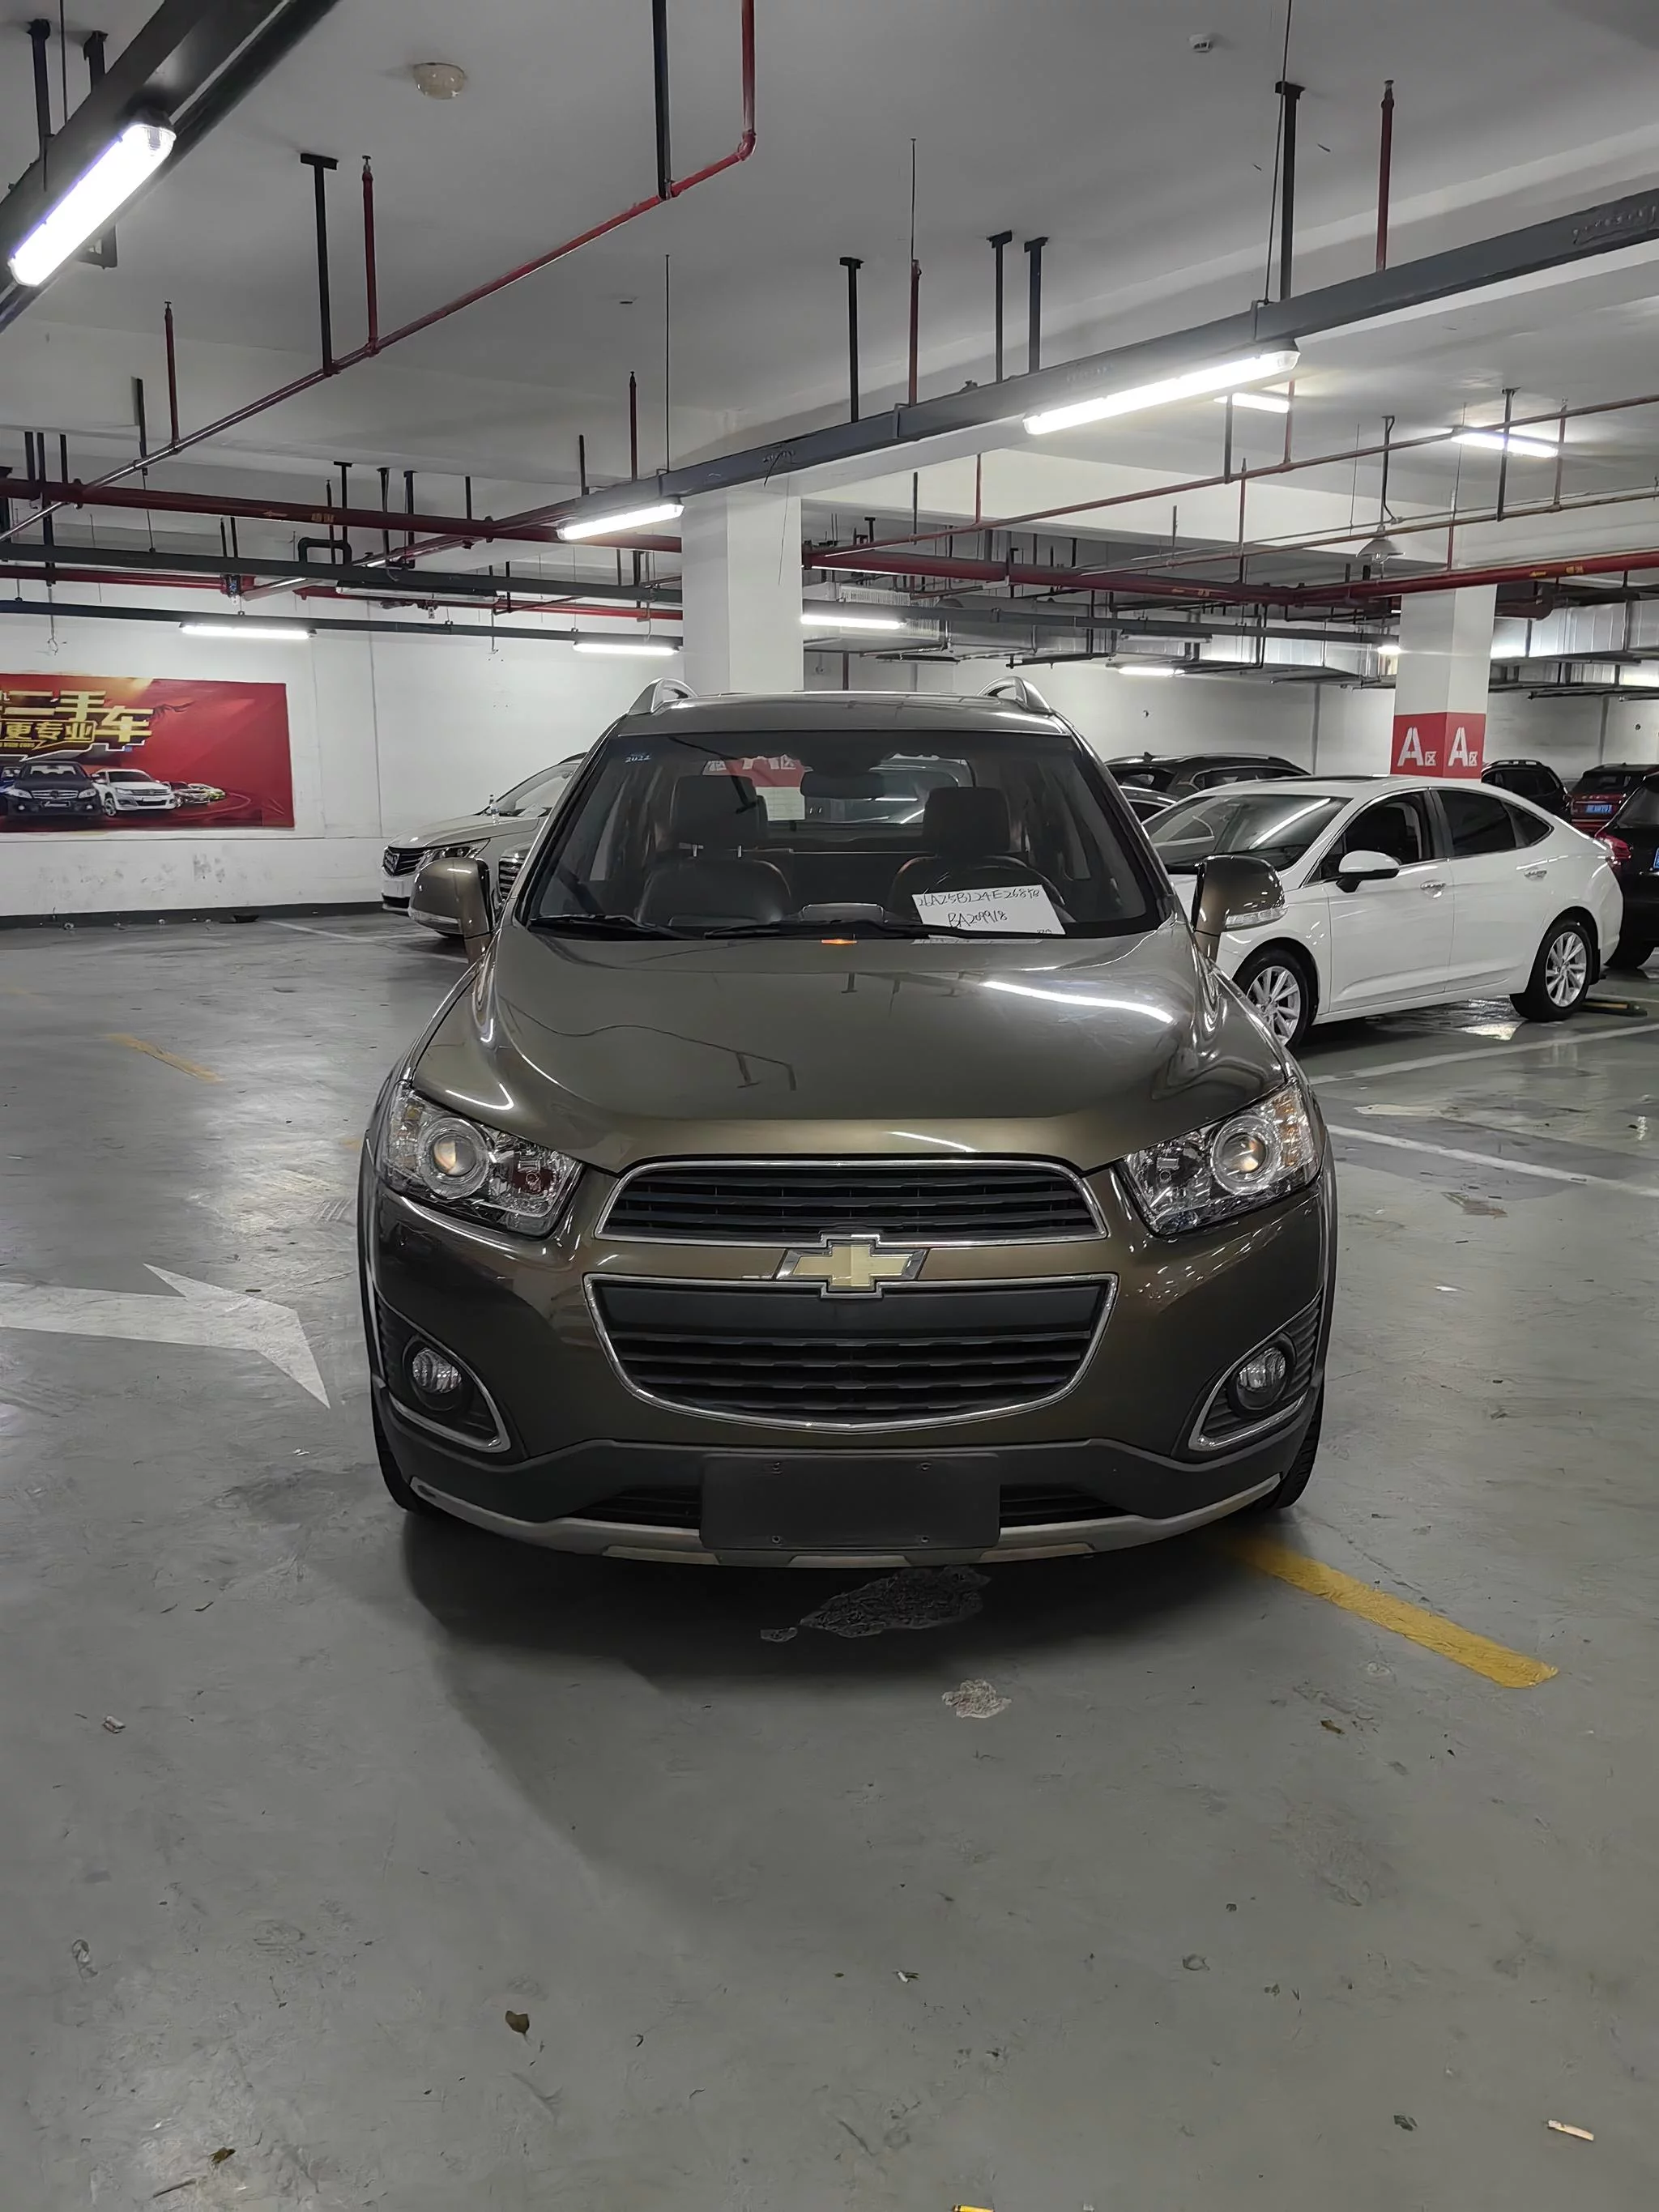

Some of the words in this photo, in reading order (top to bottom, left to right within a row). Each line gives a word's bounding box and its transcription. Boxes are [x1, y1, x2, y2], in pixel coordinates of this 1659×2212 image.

[0, 690, 154, 743] 二手车
[0, 722, 92, 740] 更专业
[1397, 727, 1437, 767] A区
[1448, 727, 1478, 767] A区
